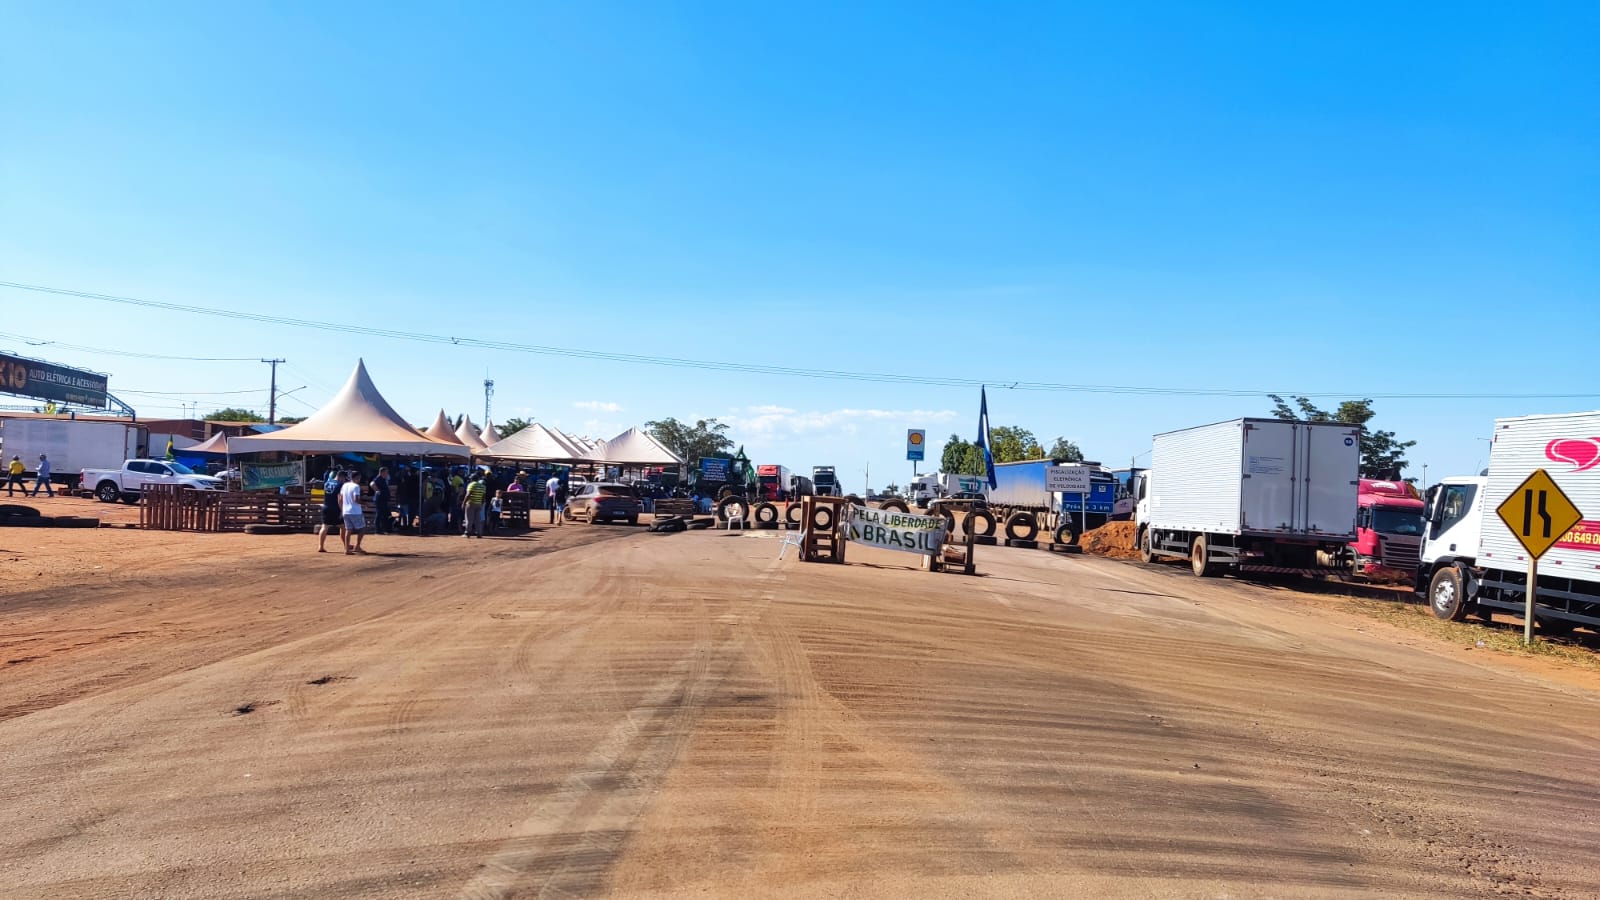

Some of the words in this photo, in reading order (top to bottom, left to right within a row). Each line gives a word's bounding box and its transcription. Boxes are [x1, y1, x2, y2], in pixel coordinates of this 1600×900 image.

[29, 369, 45, 380] AUTO
[853, 509, 880, 524] PELA
[884, 514, 941, 530] LIBERDADE
[863, 524, 936, 551] BRASIL
[1574, 532, 1591, 545] 649
[1593, 533, 1600, 545] 0
